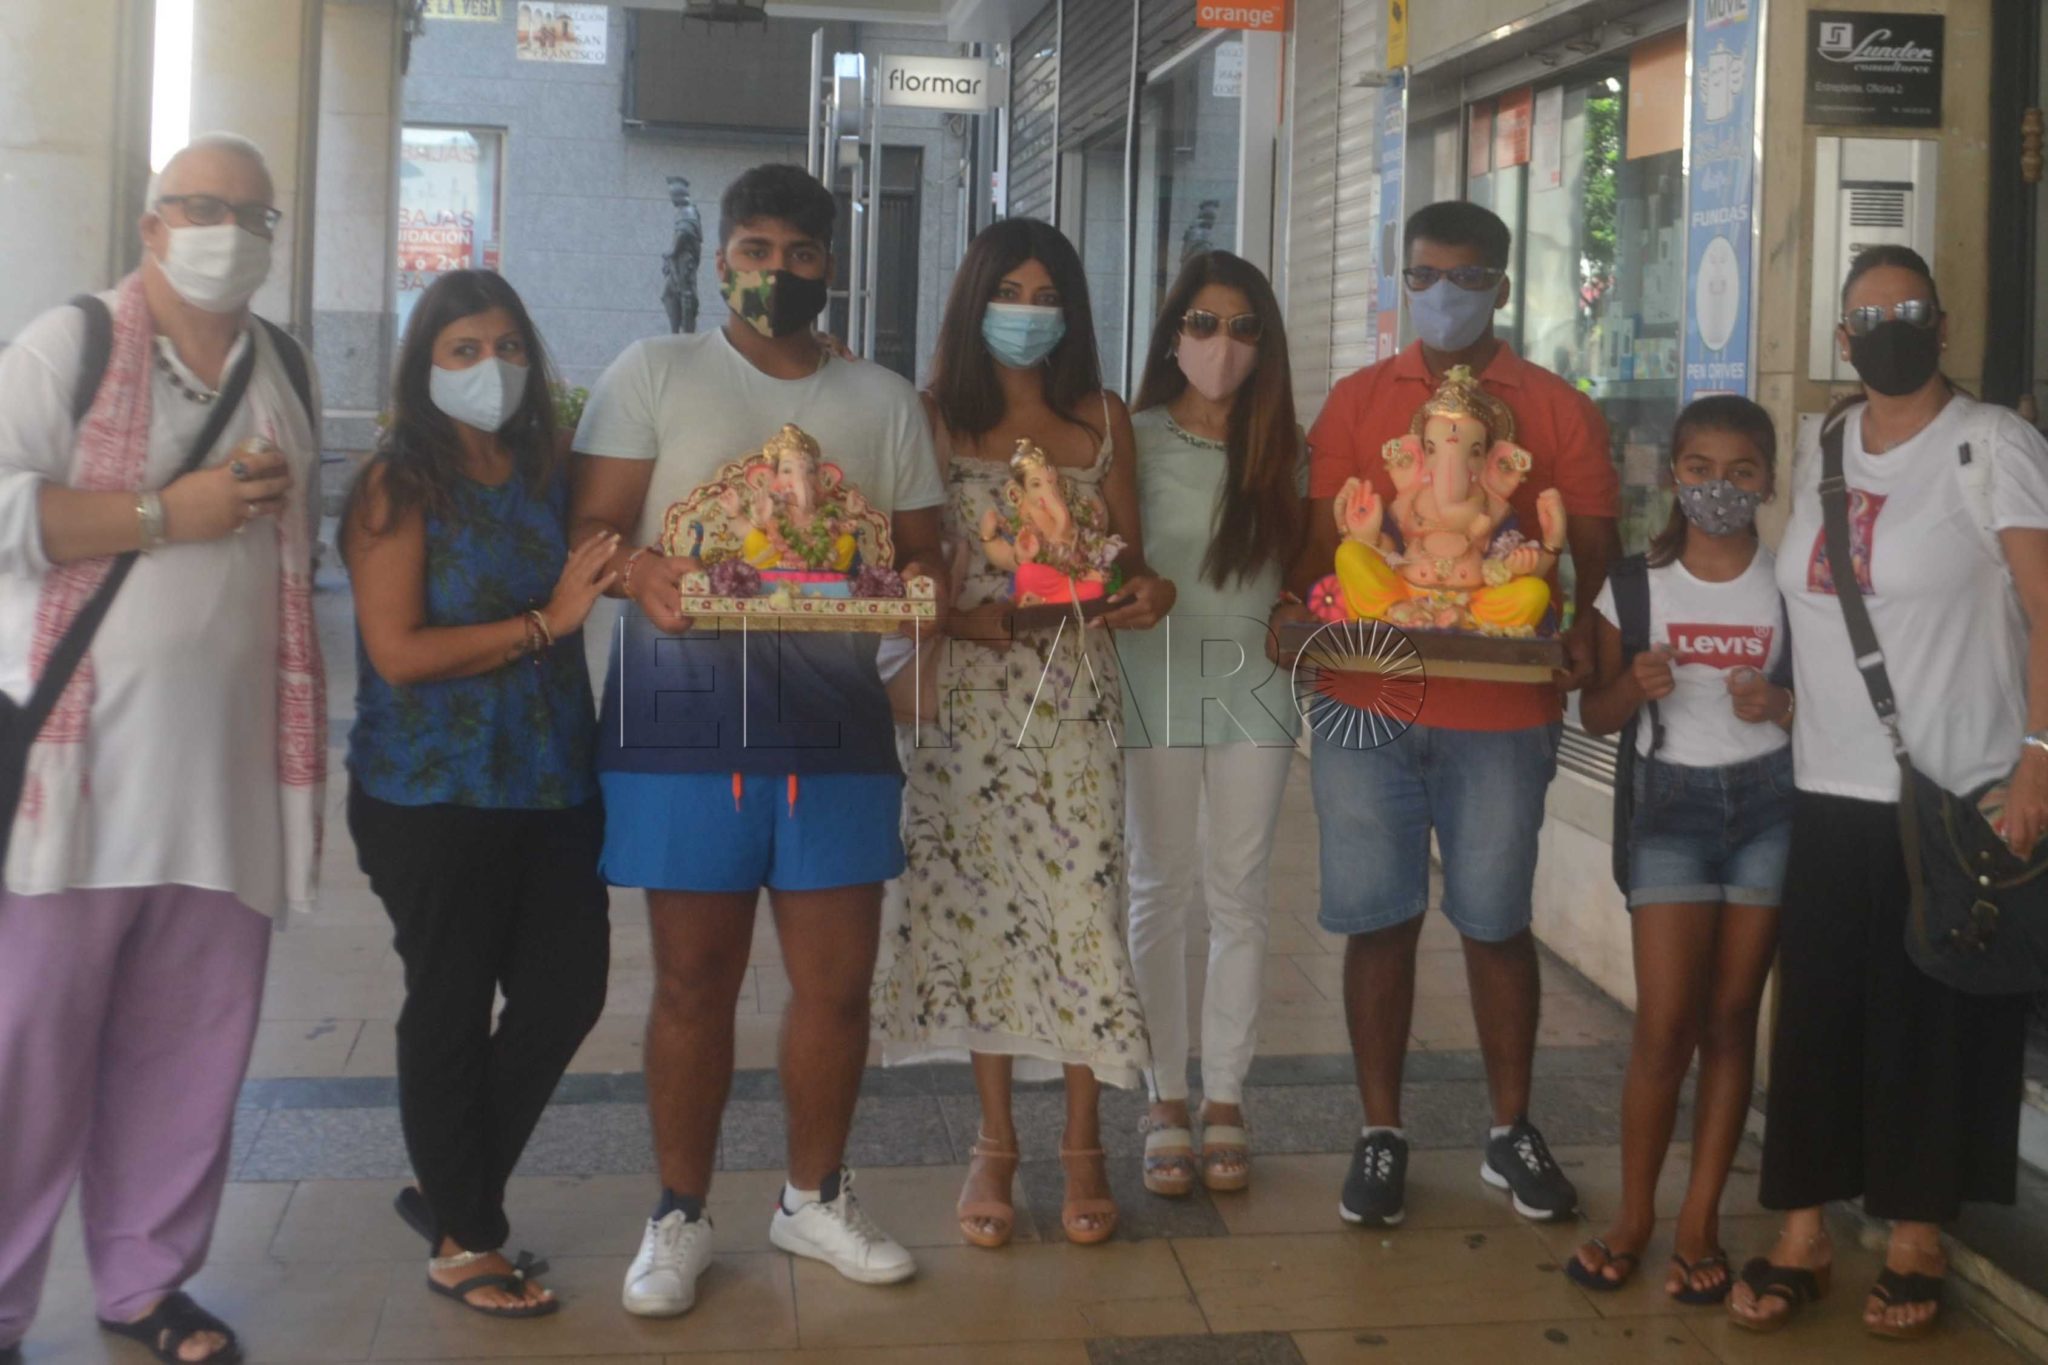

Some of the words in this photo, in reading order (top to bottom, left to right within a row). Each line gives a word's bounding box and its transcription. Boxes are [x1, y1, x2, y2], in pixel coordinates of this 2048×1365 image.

[463, 0, 498, 17] VEGA
[1201, 6, 1275, 28] orange
[575, 35, 601, 46] SAN
[889, 69, 982, 95] flormar
[1692, 204, 1748, 228] FUNDAS
[1687, 363, 1705, 381] PEN
[1708, 362, 1745, 380] DRIVES
